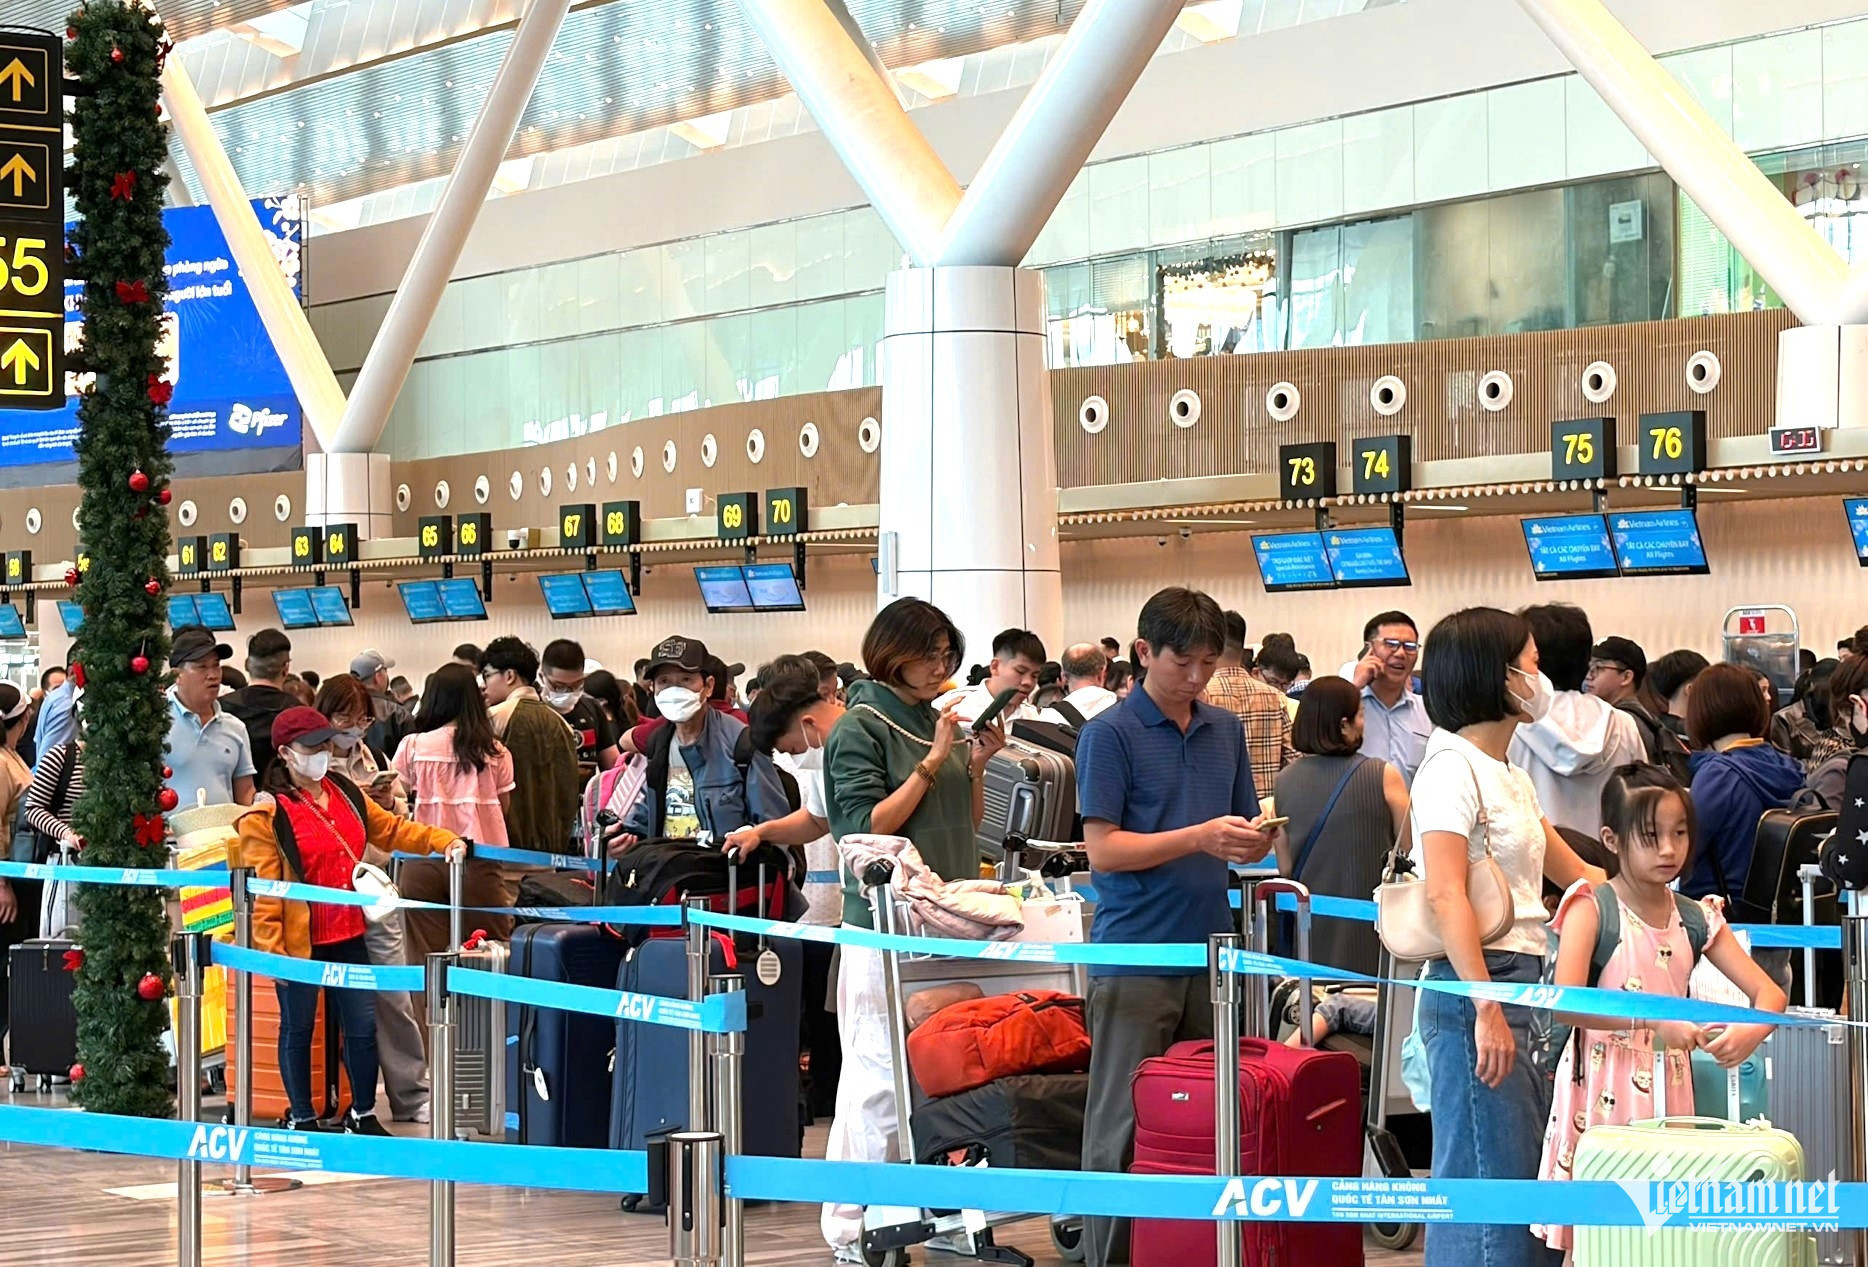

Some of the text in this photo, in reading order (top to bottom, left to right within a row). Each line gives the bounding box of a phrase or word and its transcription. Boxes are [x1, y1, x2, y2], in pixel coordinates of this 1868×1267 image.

[0, 237, 49, 296] 5
[250, 408, 288, 436] Pfizer
[1563, 433, 1594, 464] 75
[1650, 428, 1683, 459] 76
[1289, 457, 1316, 485] 73
[1362, 450, 1390, 479] 74
[606, 511, 625, 535] 68
[722, 504, 743, 528] 69
[772, 499, 792, 523] 70
[1628, 518, 1680, 528] Vietnam Airlines
[422, 525, 439, 547] 65
[460, 523, 478, 545] 66
[563, 514, 582, 538] 67
[1543, 524, 1591, 533] Vietnam Airlines
[181, 545, 193, 563] 61
[212, 541, 227, 562] 62
[294, 535, 310, 557] 63
[330, 533, 345, 555] 64
[1218, 947, 1239, 970] CV
[321, 963, 347, 987] ACV
[616, 991, 656, 1020] ACV
[187, 1125, 248, 1161] ACV
[1332, 1178, 1426, 1192] CẢNG HÀNG KHÔNG
[1212, 1178, 1319, 1217] ACV
[1331, 1192, 1448, 1205] QUỐC TẾ TÂN SƠN NHẤT
